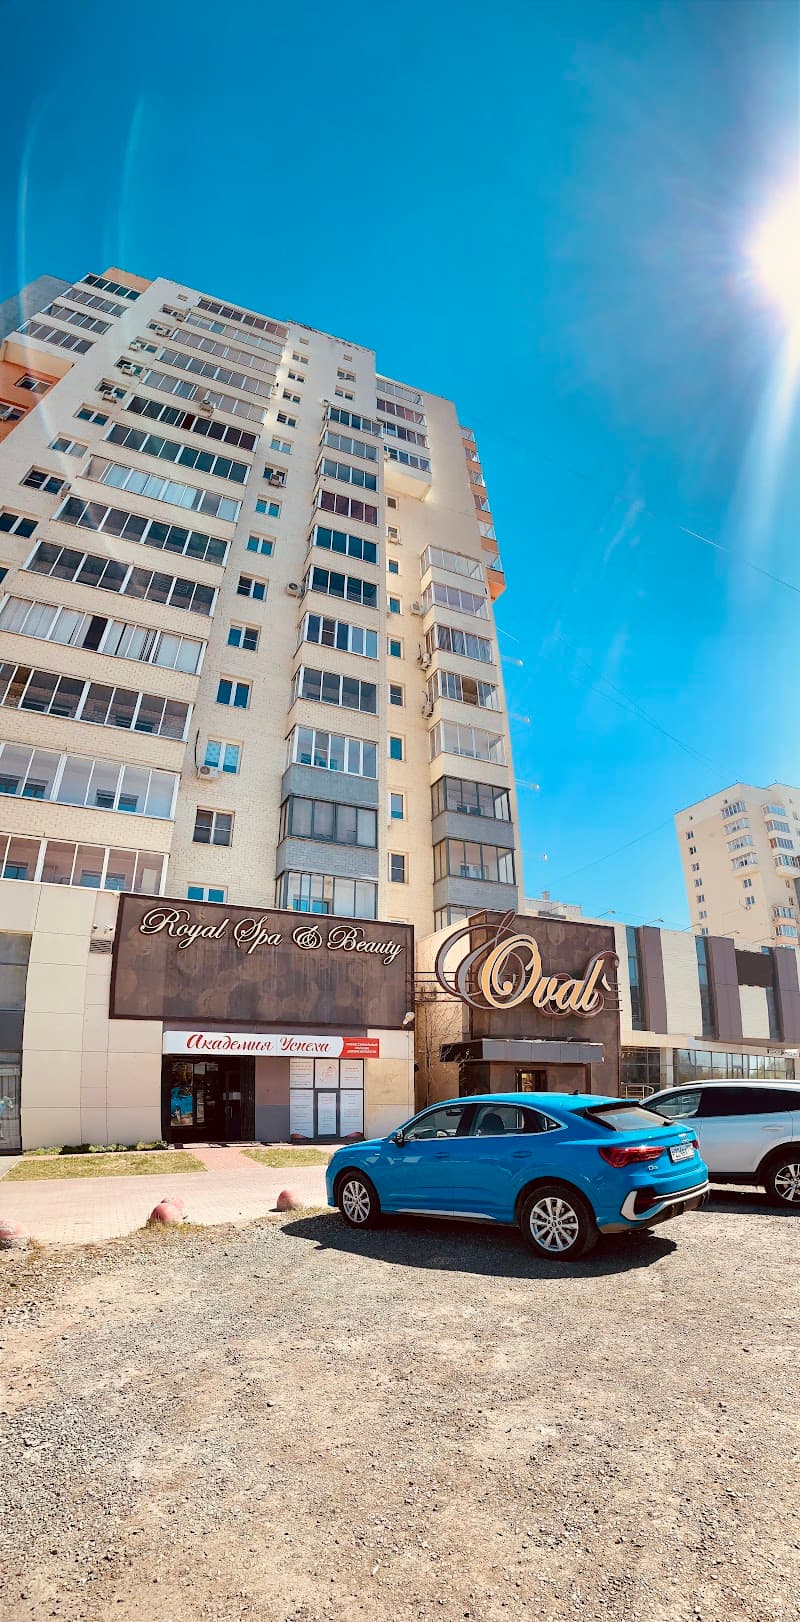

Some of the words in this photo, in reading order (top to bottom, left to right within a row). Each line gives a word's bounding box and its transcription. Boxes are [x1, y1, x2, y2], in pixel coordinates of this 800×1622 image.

[140, 907, 229, 948] Royal
[234, 916, 283, 954] Spa
[293, 925, 322, 950] &
[327, 925, 402, 965] Beauty
[187, 1034, 273, 1052] Академия
[280, 1037, 330, 1053] Успеха
